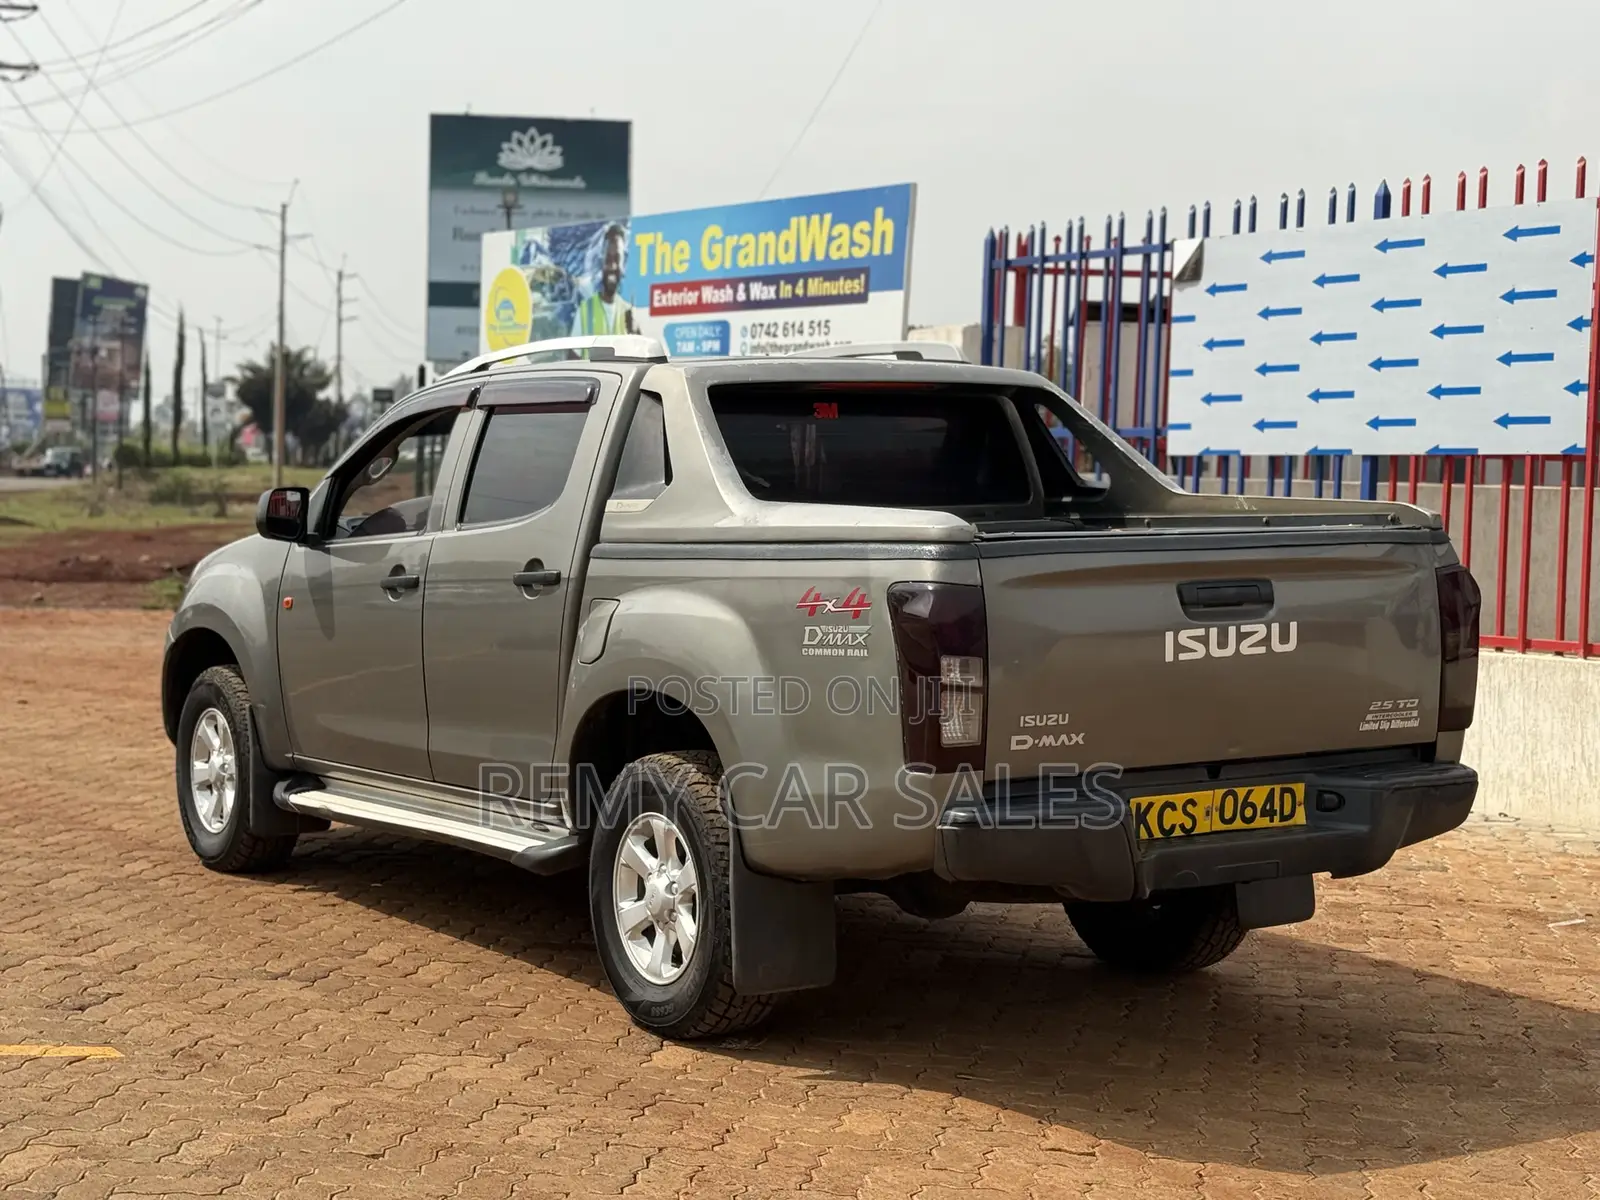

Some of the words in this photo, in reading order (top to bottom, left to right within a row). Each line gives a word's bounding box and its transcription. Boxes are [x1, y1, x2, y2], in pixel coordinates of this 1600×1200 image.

[635, 232, 691, 277] The
[701, 207, 895, 271] GrandWash
[652, 287, 699, 308] Exterior
[701, 284, 733, 304] Wash
[736, 283, 746, 302] &
[749, 281, 777, 301] Wax
[779, 280, 792, 298] In
[795, 278, 804, 297] 4
[807, 273, 866, 297] Minutes!
[674, 327, 696, 339] OPEN
[751, 322, 778, 339] 0742
[782, 321, 804, 338] 614
[808, 320, 831, 337] 515
[813, 402, 839, 419] 3M
[825, 625, 849, 633] ISUZU
[1165, 621, 1298, 662] ISUZU
[802, 648, 845, 657] COMMON
[847, 648, 869, 657] RAIL
[1396, 698, 1420, 709] TD
[1020, 713, 1069, 728] ISUZU
[1135, 798, 1198, 838] KCS
[1218, 786, 1297, 826] 064D
